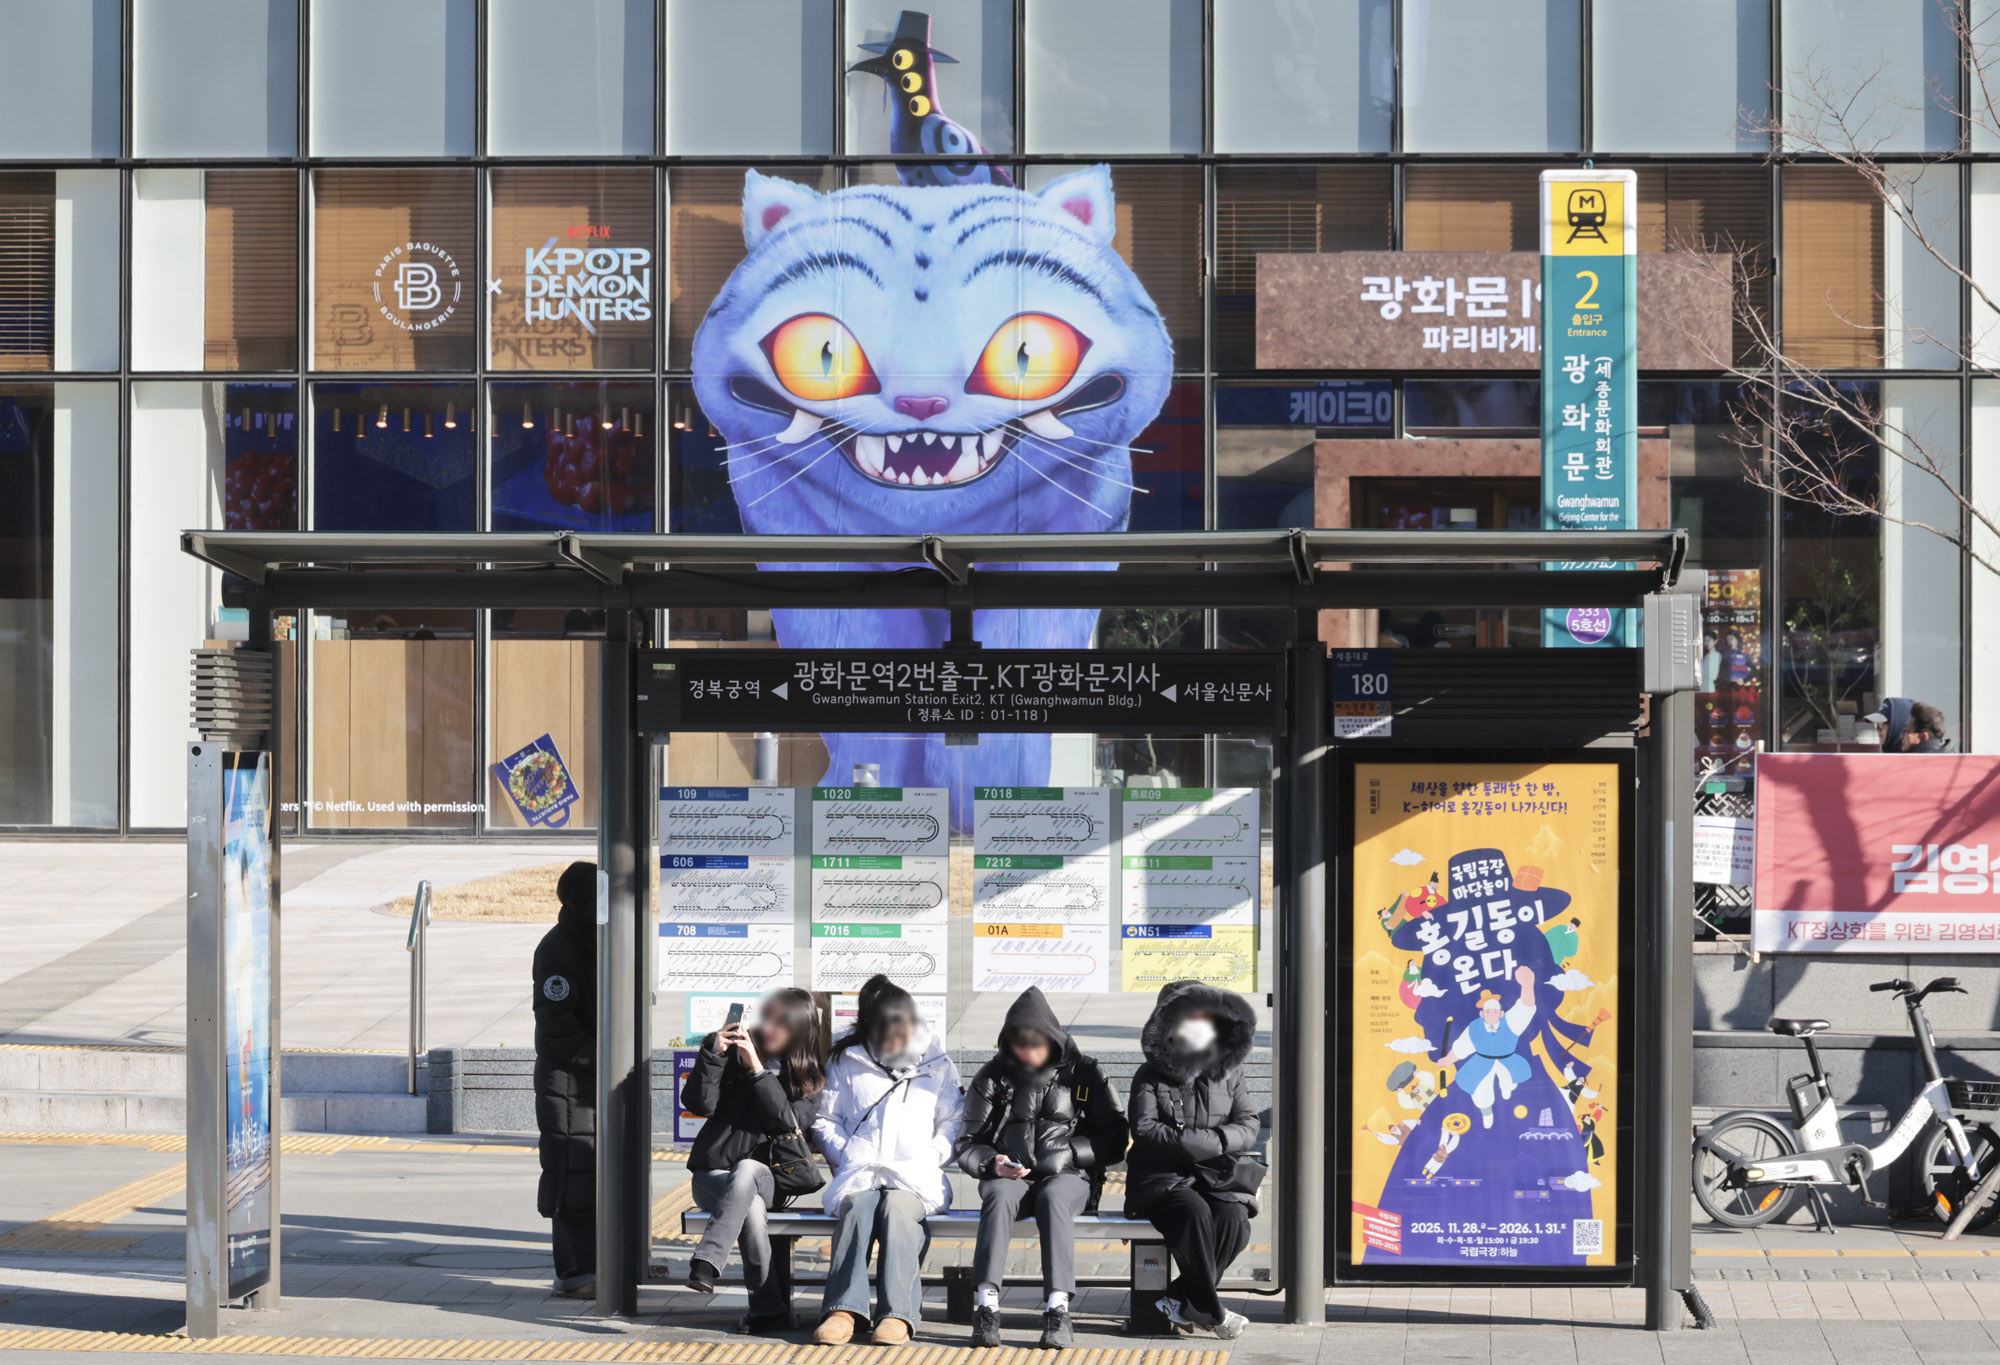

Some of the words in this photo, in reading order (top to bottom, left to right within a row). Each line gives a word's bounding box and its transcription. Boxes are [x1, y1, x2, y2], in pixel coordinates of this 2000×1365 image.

[567, 225, 611, 239] NETFLIX
[375, 246, 402, 278] PARIS
[406, 241, 460, 277] BAGUETTE
[525, 268, 650, 303] DEMON
[1574, 270, 1600, 310] 2
[1360, 276, 1509, 320] 광화문
[380, 304, 456, 331] BOULANGERIE
[525, 298, 651, 336] HUNTERS
[1571, 313, 1604, 326] 출입구
[1422, 325, 1542, 353] 파리바게
[1567, 327, 1608, 337] Entrance
[1561, 354, 1591, 482] 광화문
[1557, 494, 1620, 511] Gwanghwamun
[1580, 512, 1600, 522] Center
[1600, 512, 1608, 522] for
[1608, 512, 1619, 522] the
[1571, 618, 1607, 632] 5호선
[793, 660, 1161, 693] 광화문역2번출구.KT광화문지사
[1351, 673, 1389, 695] 180
[689, 679, 760, 699] 경복궁역
[1183, 682, 1272, 702] 서울신문사
[812, 692, 900, 706] Gwanghwamun
[904, 693, 947, 705] Station
[989, 693, 1005, 705] KT
[1010, 693, 1103, 708] (Gwanghwamun
[1108, 694, 1142, 708] Bldg.)
[917, 708, 956, 722] 정류소
[960, 709, 974, 721] ID
[990, 709, 1038, 721] 01-118
[677, 788, 697, 799] 109
[822, 788, 851, 799] 1020
[983, 788, 1013, 799] 7018
[1410, 782, 1449, 796] 세상을
[1452, 781, 1478, 796] 향한
[1482, 781, 1521, 798] 통쾌한
[1525, 781, 1538, 796] 한
[1542, 781, 1560, 798] 방,
[325, 801, 365, 812] Netflix.
[367, 801, 395, 812] Used
[396, 801, 422, 812] with
[423, 801, 487, 815] permission.
[1402, 800, 1457, 814] K-히어로
[1461, 800, 1507, 815] 홍길동이
[1512, 800, 1568, 815] 나가신다!
[672, 856, 694, 868] 606
[822, 856, 850, 868] 1711
[985, 857, 1012, 868] 7212
[1891, 843, 2000, 895] 김영
[1451, 858, 1505, 883] 국립극장
[1451, 877, 1509, 901] 마당놀이
[676, 925, 697, 936] 708
[823, 925, 850, 936] 7016
[987, 924, 1009, 936] 01A
[1138, 926, 1160, 937] N51
[1415, 899, 1545, 966] 홍길동이
[1787, 920, 1887, 941] KT정상화를
[1893, 922, 1933, 941] 위한
[1452, 948, 1518, 996] 온다
[1410, 1222, 1444, 1234] 2025.
[1447, 1222, 1461, 1234] 11.
[1498, 1223, 1533, 1234] 2026.
[1535, 1223, 1544, 1234] 1.
[1367, 1236, 1399, 1252] 2025-2026
[1510, 1236, 1518, 1244] 금
[1459, 1247, 1499, 1258] 국립극장
[1499, 1247, 1519, 1258] 하늘
